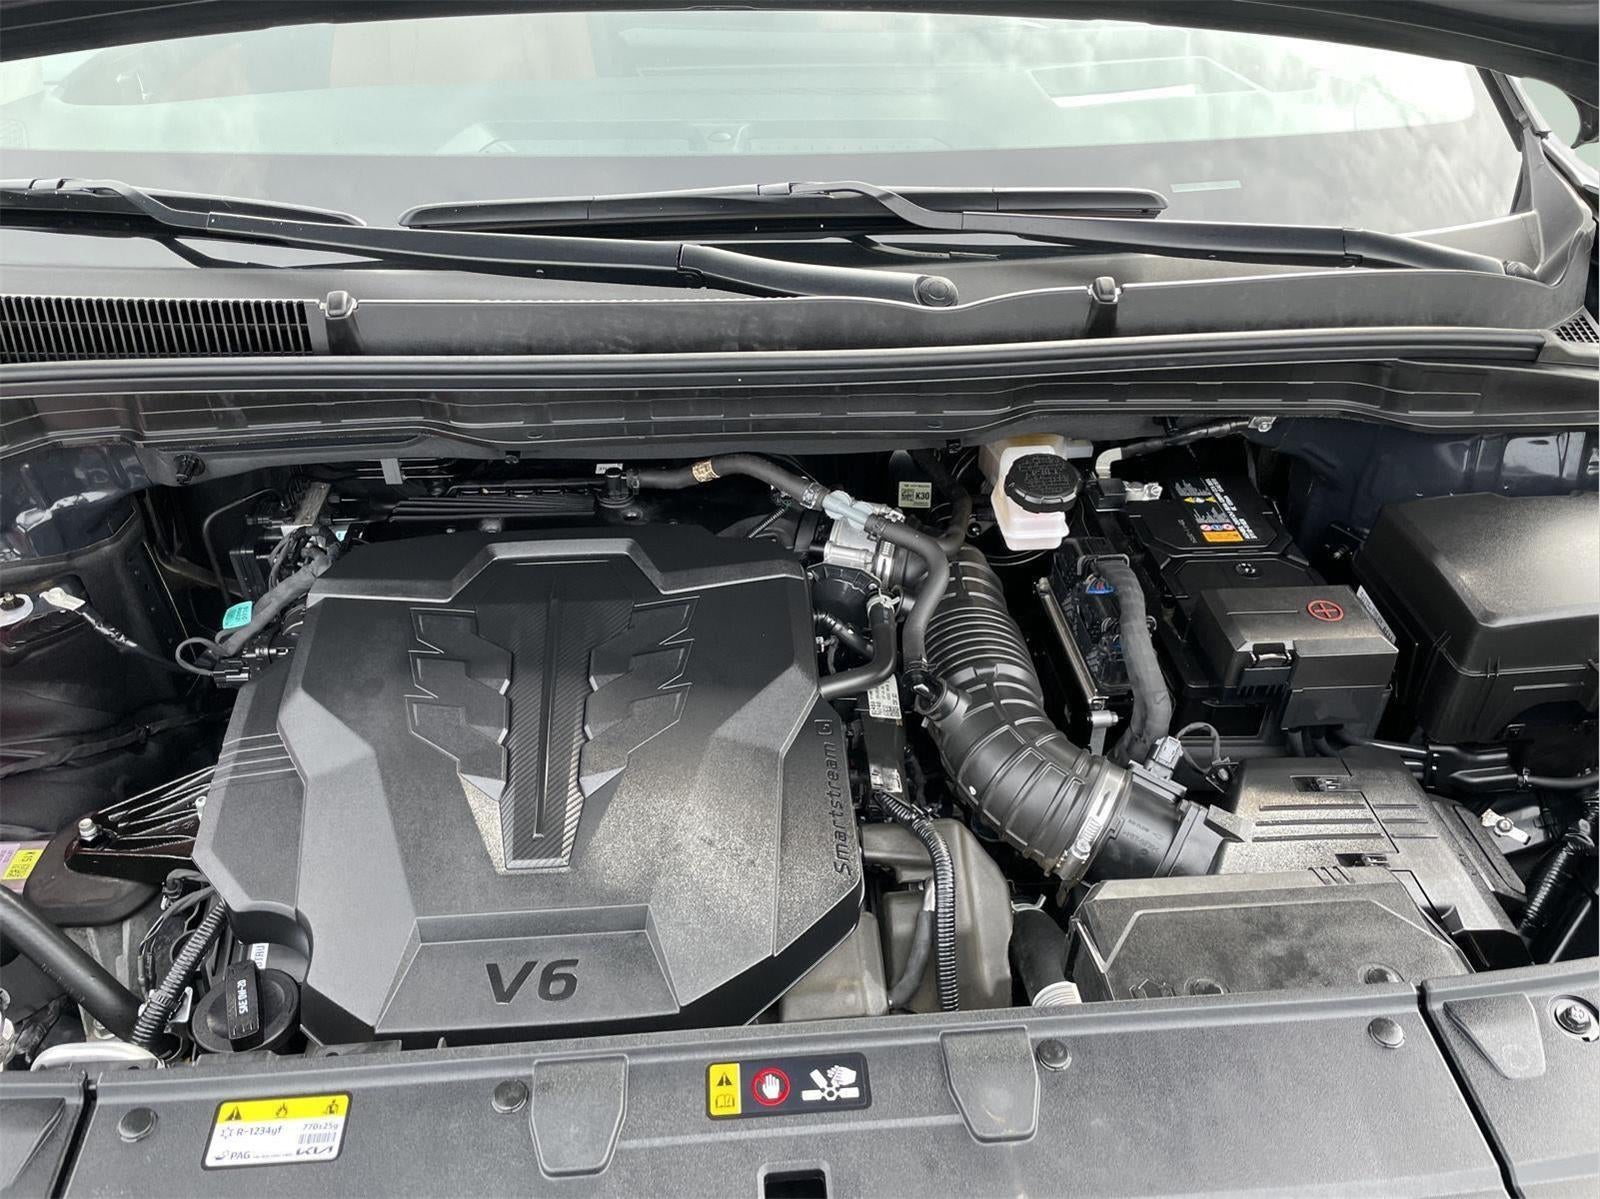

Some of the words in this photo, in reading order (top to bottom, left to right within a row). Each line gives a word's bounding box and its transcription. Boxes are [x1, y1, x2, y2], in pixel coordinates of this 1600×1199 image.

[915, 491, 930, 500] K30
[823, 741, 851, 876] Smartstream
[485, 959, 579, 1004] V6
[238, 999, 249, 1014] SAE
[236, 1124, 283, 1138] R-1234yf
[230, 1151, 251, 1160] PAG
